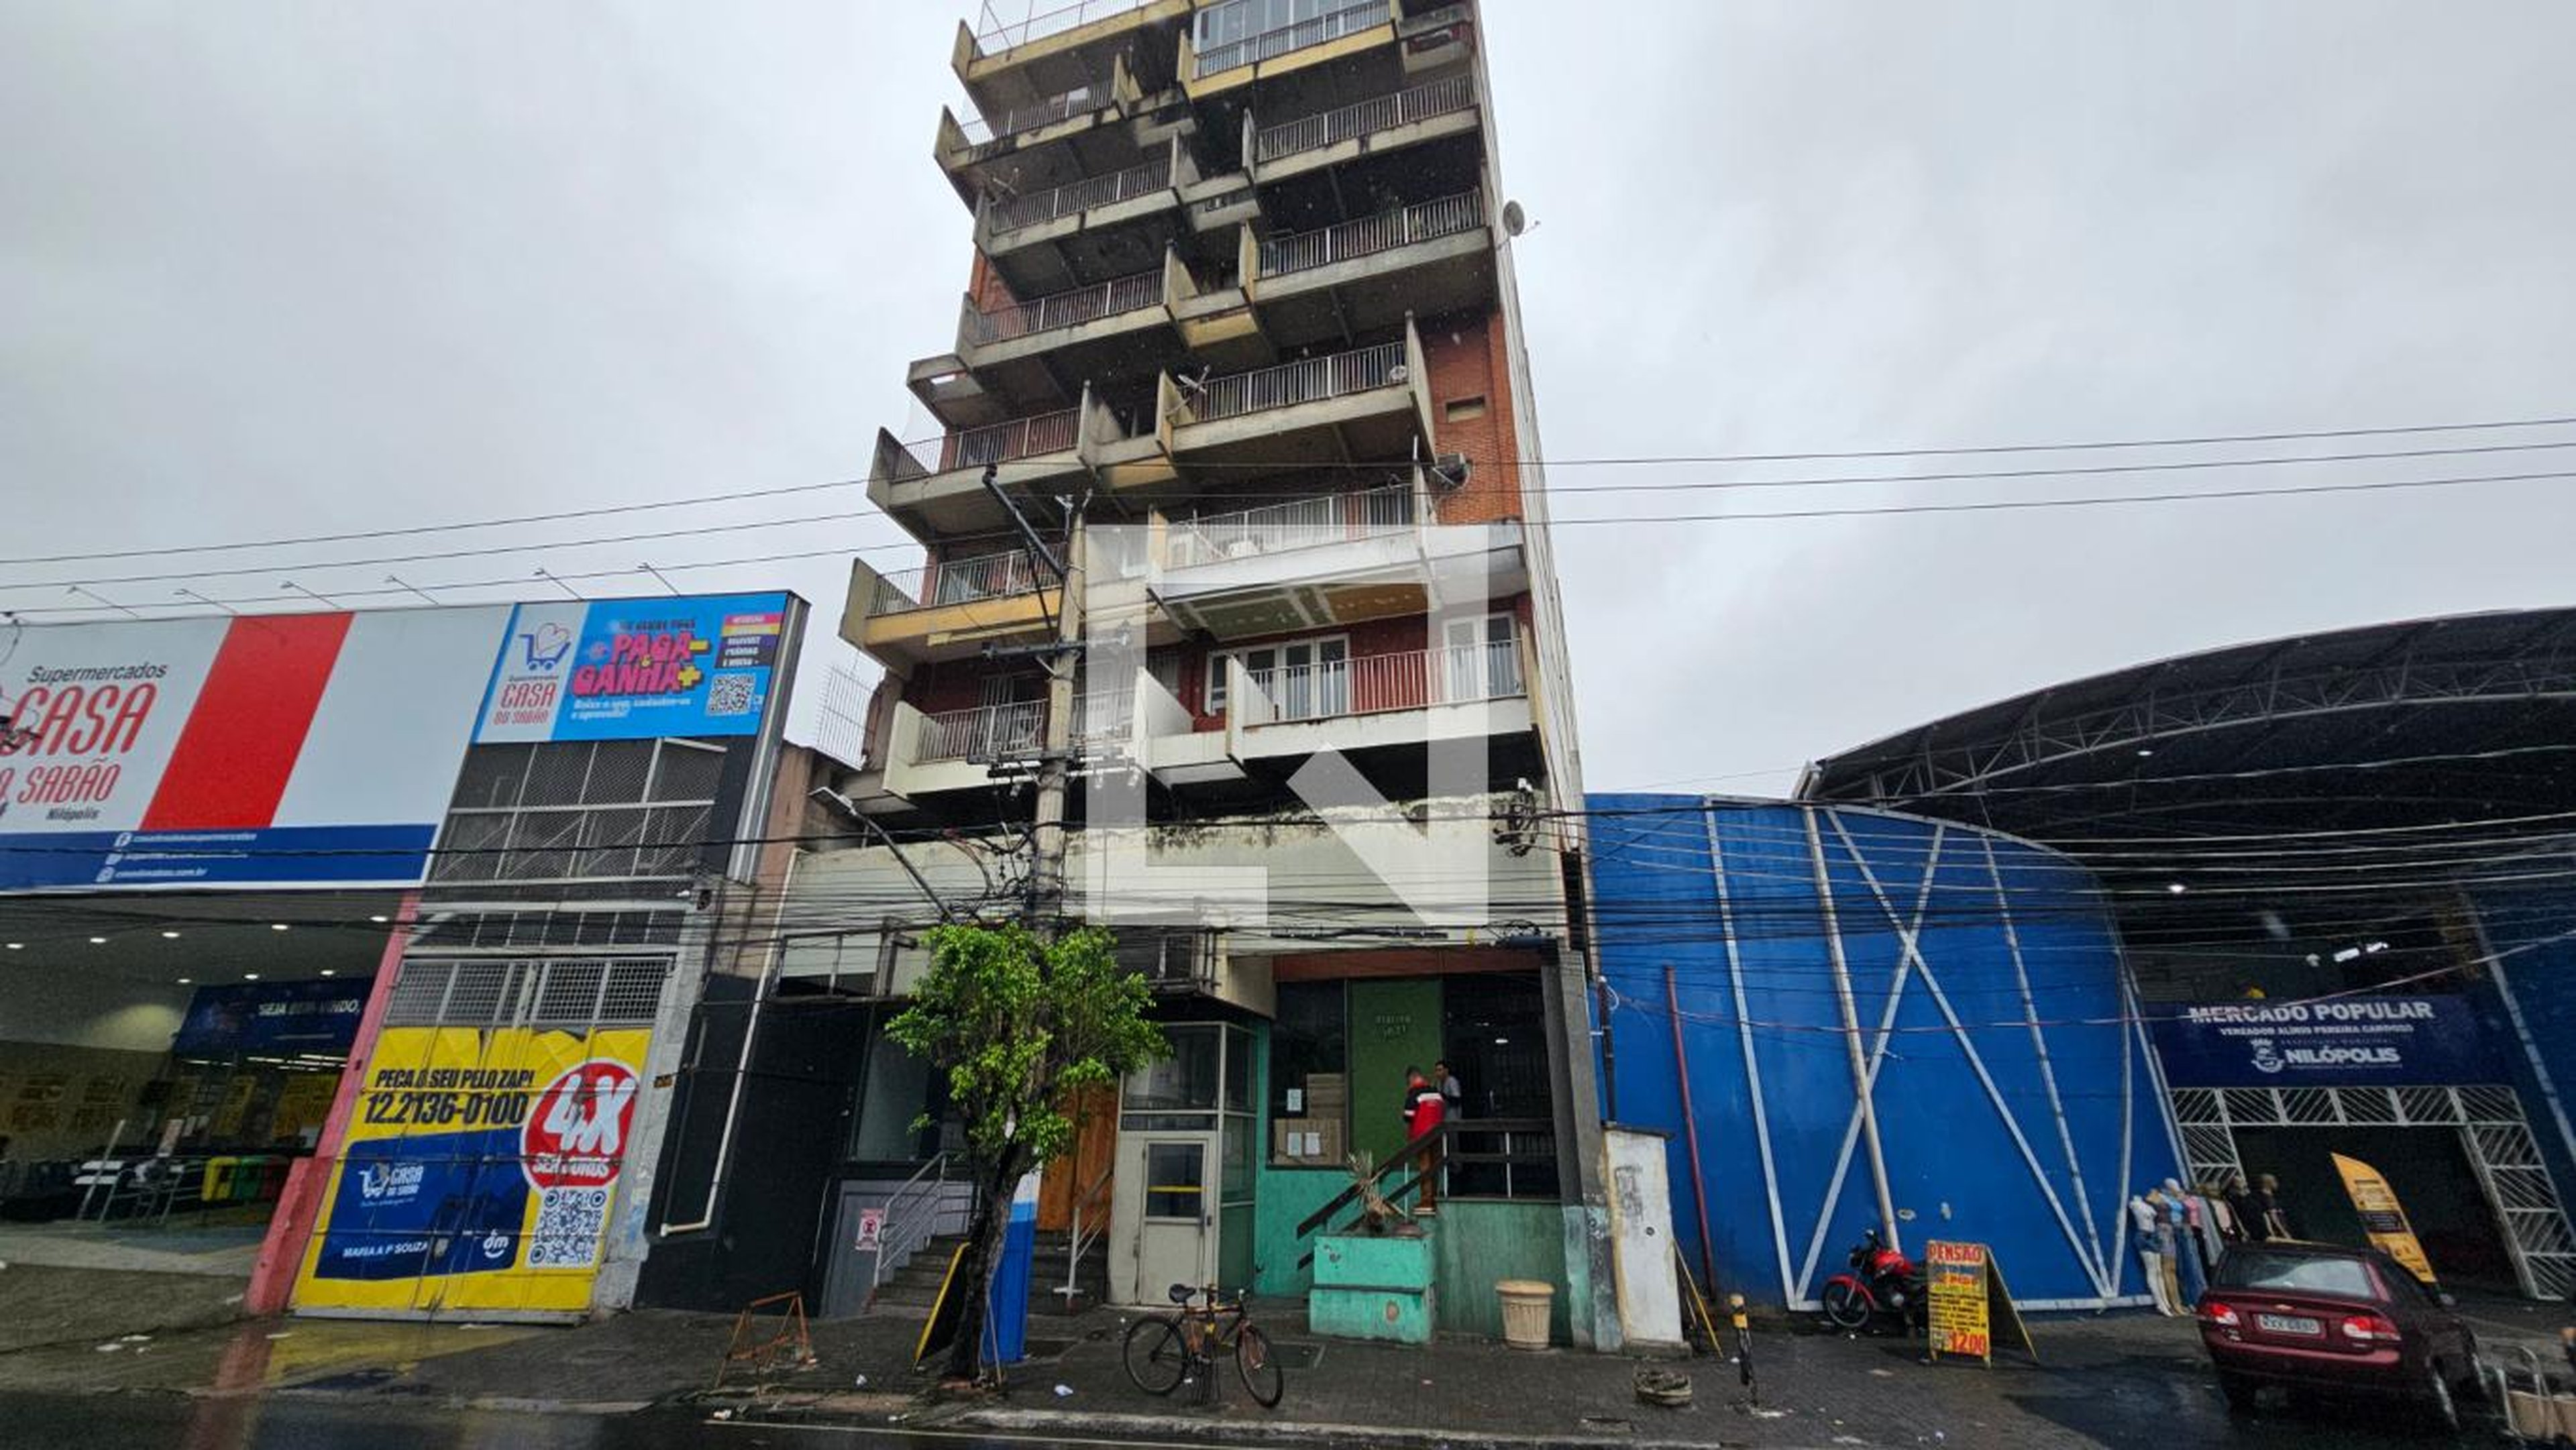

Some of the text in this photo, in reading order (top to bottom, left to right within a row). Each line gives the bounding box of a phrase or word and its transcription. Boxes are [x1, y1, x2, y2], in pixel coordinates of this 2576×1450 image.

[27, 662, 168, 686] Supermercados
[500, 683, 556, 709] CASA
[0, 682, 158, 757] CASA
[17, 757, 121, 803] SABÃO
[2189, 1001, 2435, 1023] MERCADO POPULAR
[2284, 1044, 2401, 1064] NILÓPOLIS
[428, 1069, 461, 1089] SEU
[460, 1069, 498, 1089] PELO
[496, 1069, 535, 1089] ZAP!
[394, 1241, 429, 1255] SOUZA
